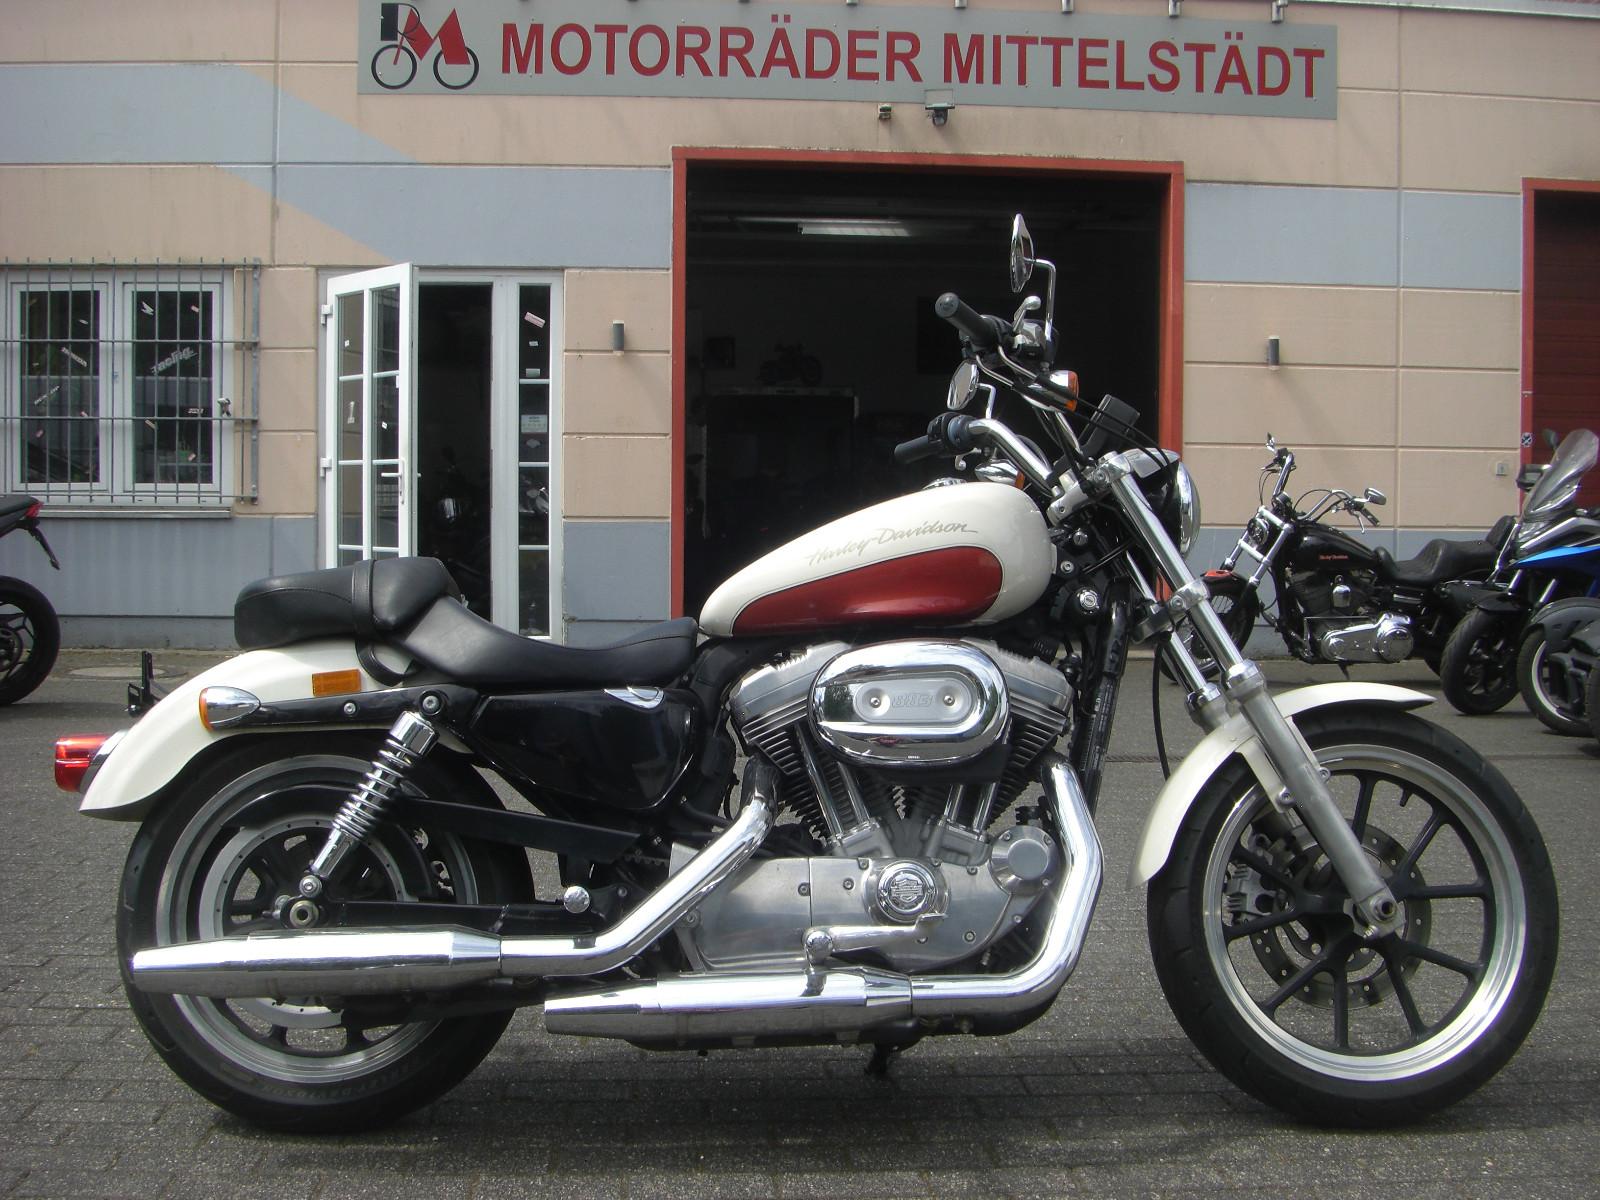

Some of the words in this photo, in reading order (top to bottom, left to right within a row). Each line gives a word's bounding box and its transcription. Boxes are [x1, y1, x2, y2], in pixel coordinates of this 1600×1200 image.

[501, 14, 923, 83] MOTORRÄDER
[943, 31, 1325, 98] MITTELSTÄDT
[804, 520, 979, 566] Harley-Davidson
